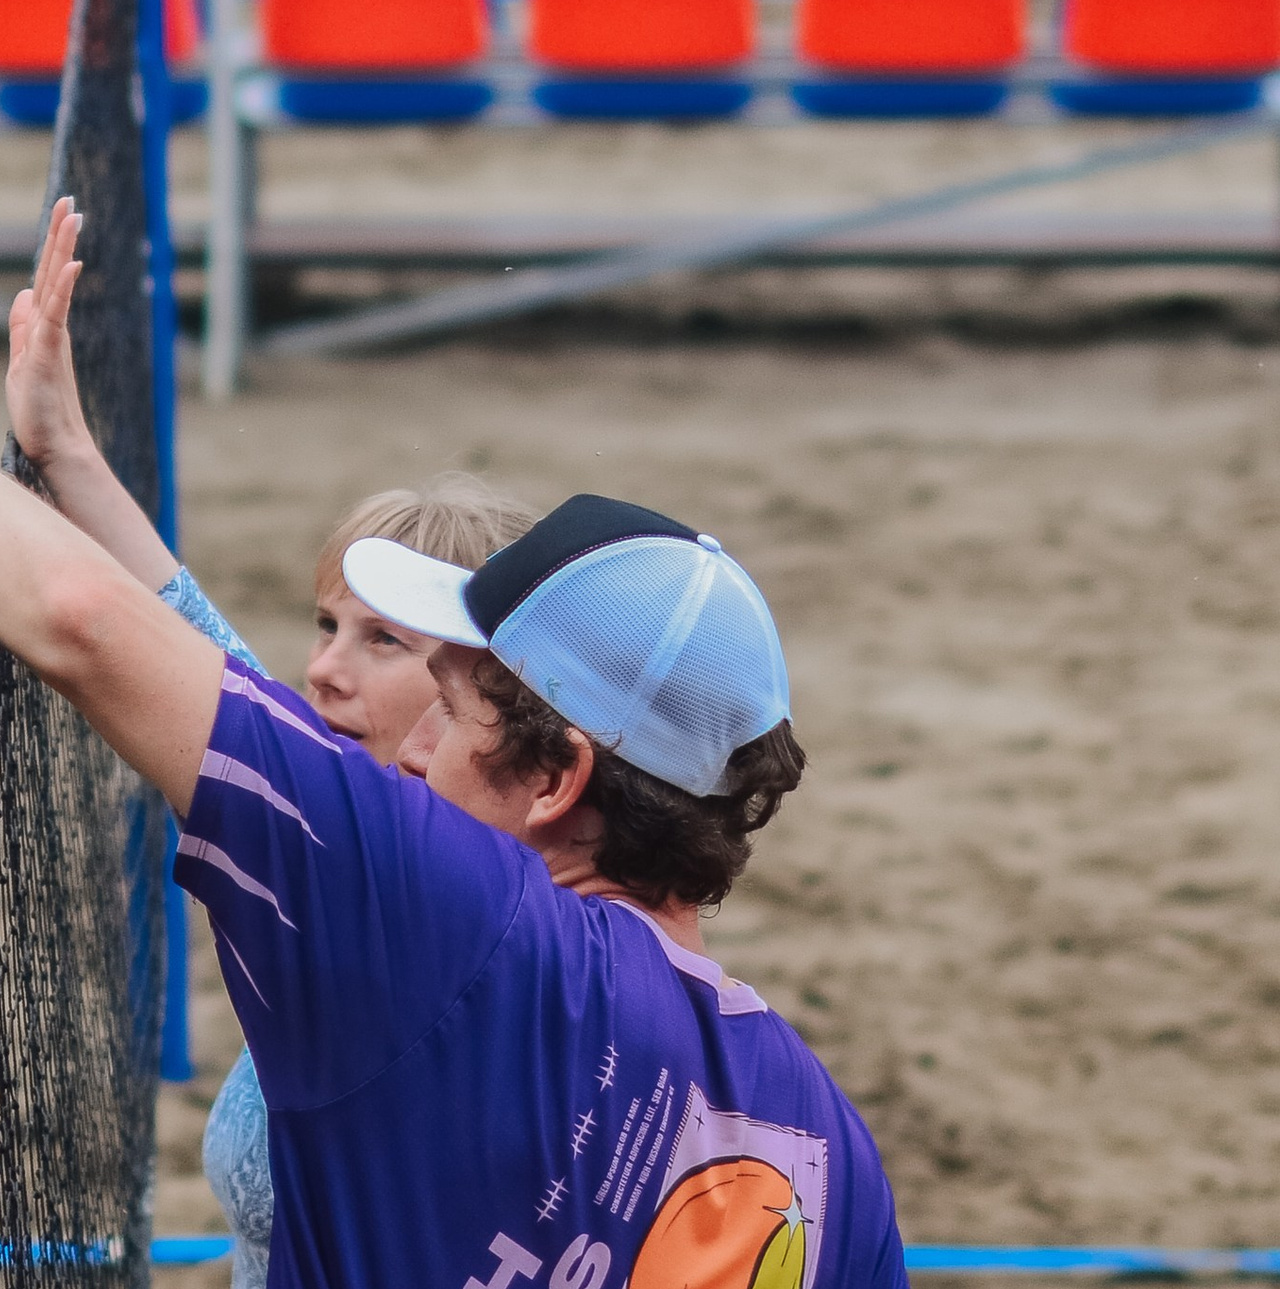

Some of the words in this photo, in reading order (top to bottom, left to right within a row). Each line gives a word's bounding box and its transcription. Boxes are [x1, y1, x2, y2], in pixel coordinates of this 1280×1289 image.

[652, 1089, 662, 1104] SED
[594, 1180, 611, 1205] LOREM
[607, 1156, 619, 1180] IPSUM
[623, 1119, 631, 1131] SIT
